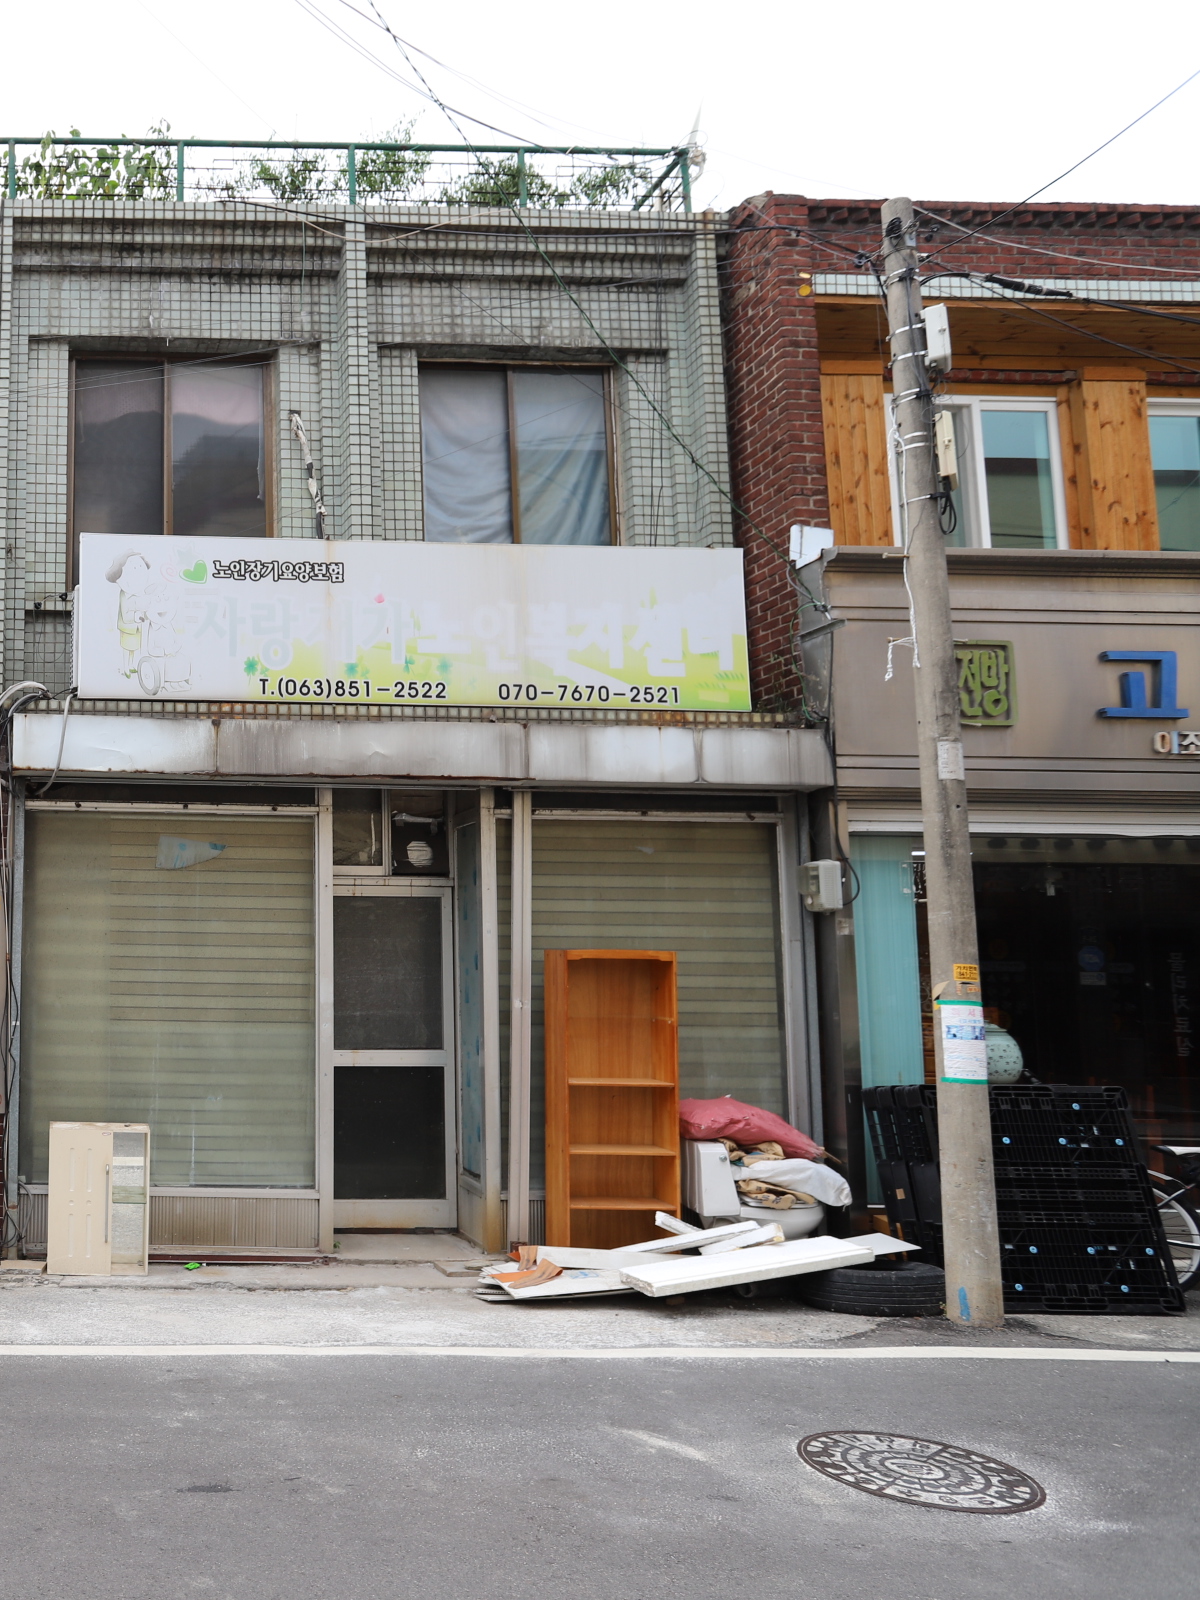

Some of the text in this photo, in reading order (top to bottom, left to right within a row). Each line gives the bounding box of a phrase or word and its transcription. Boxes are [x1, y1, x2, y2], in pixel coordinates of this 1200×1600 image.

[212, 559, 345, 583] 노인장기요양보험
[259, 678, 680, 704] T.(063)851-2522 070-7670-2521
[1097, 650, 1190, 718] 고
